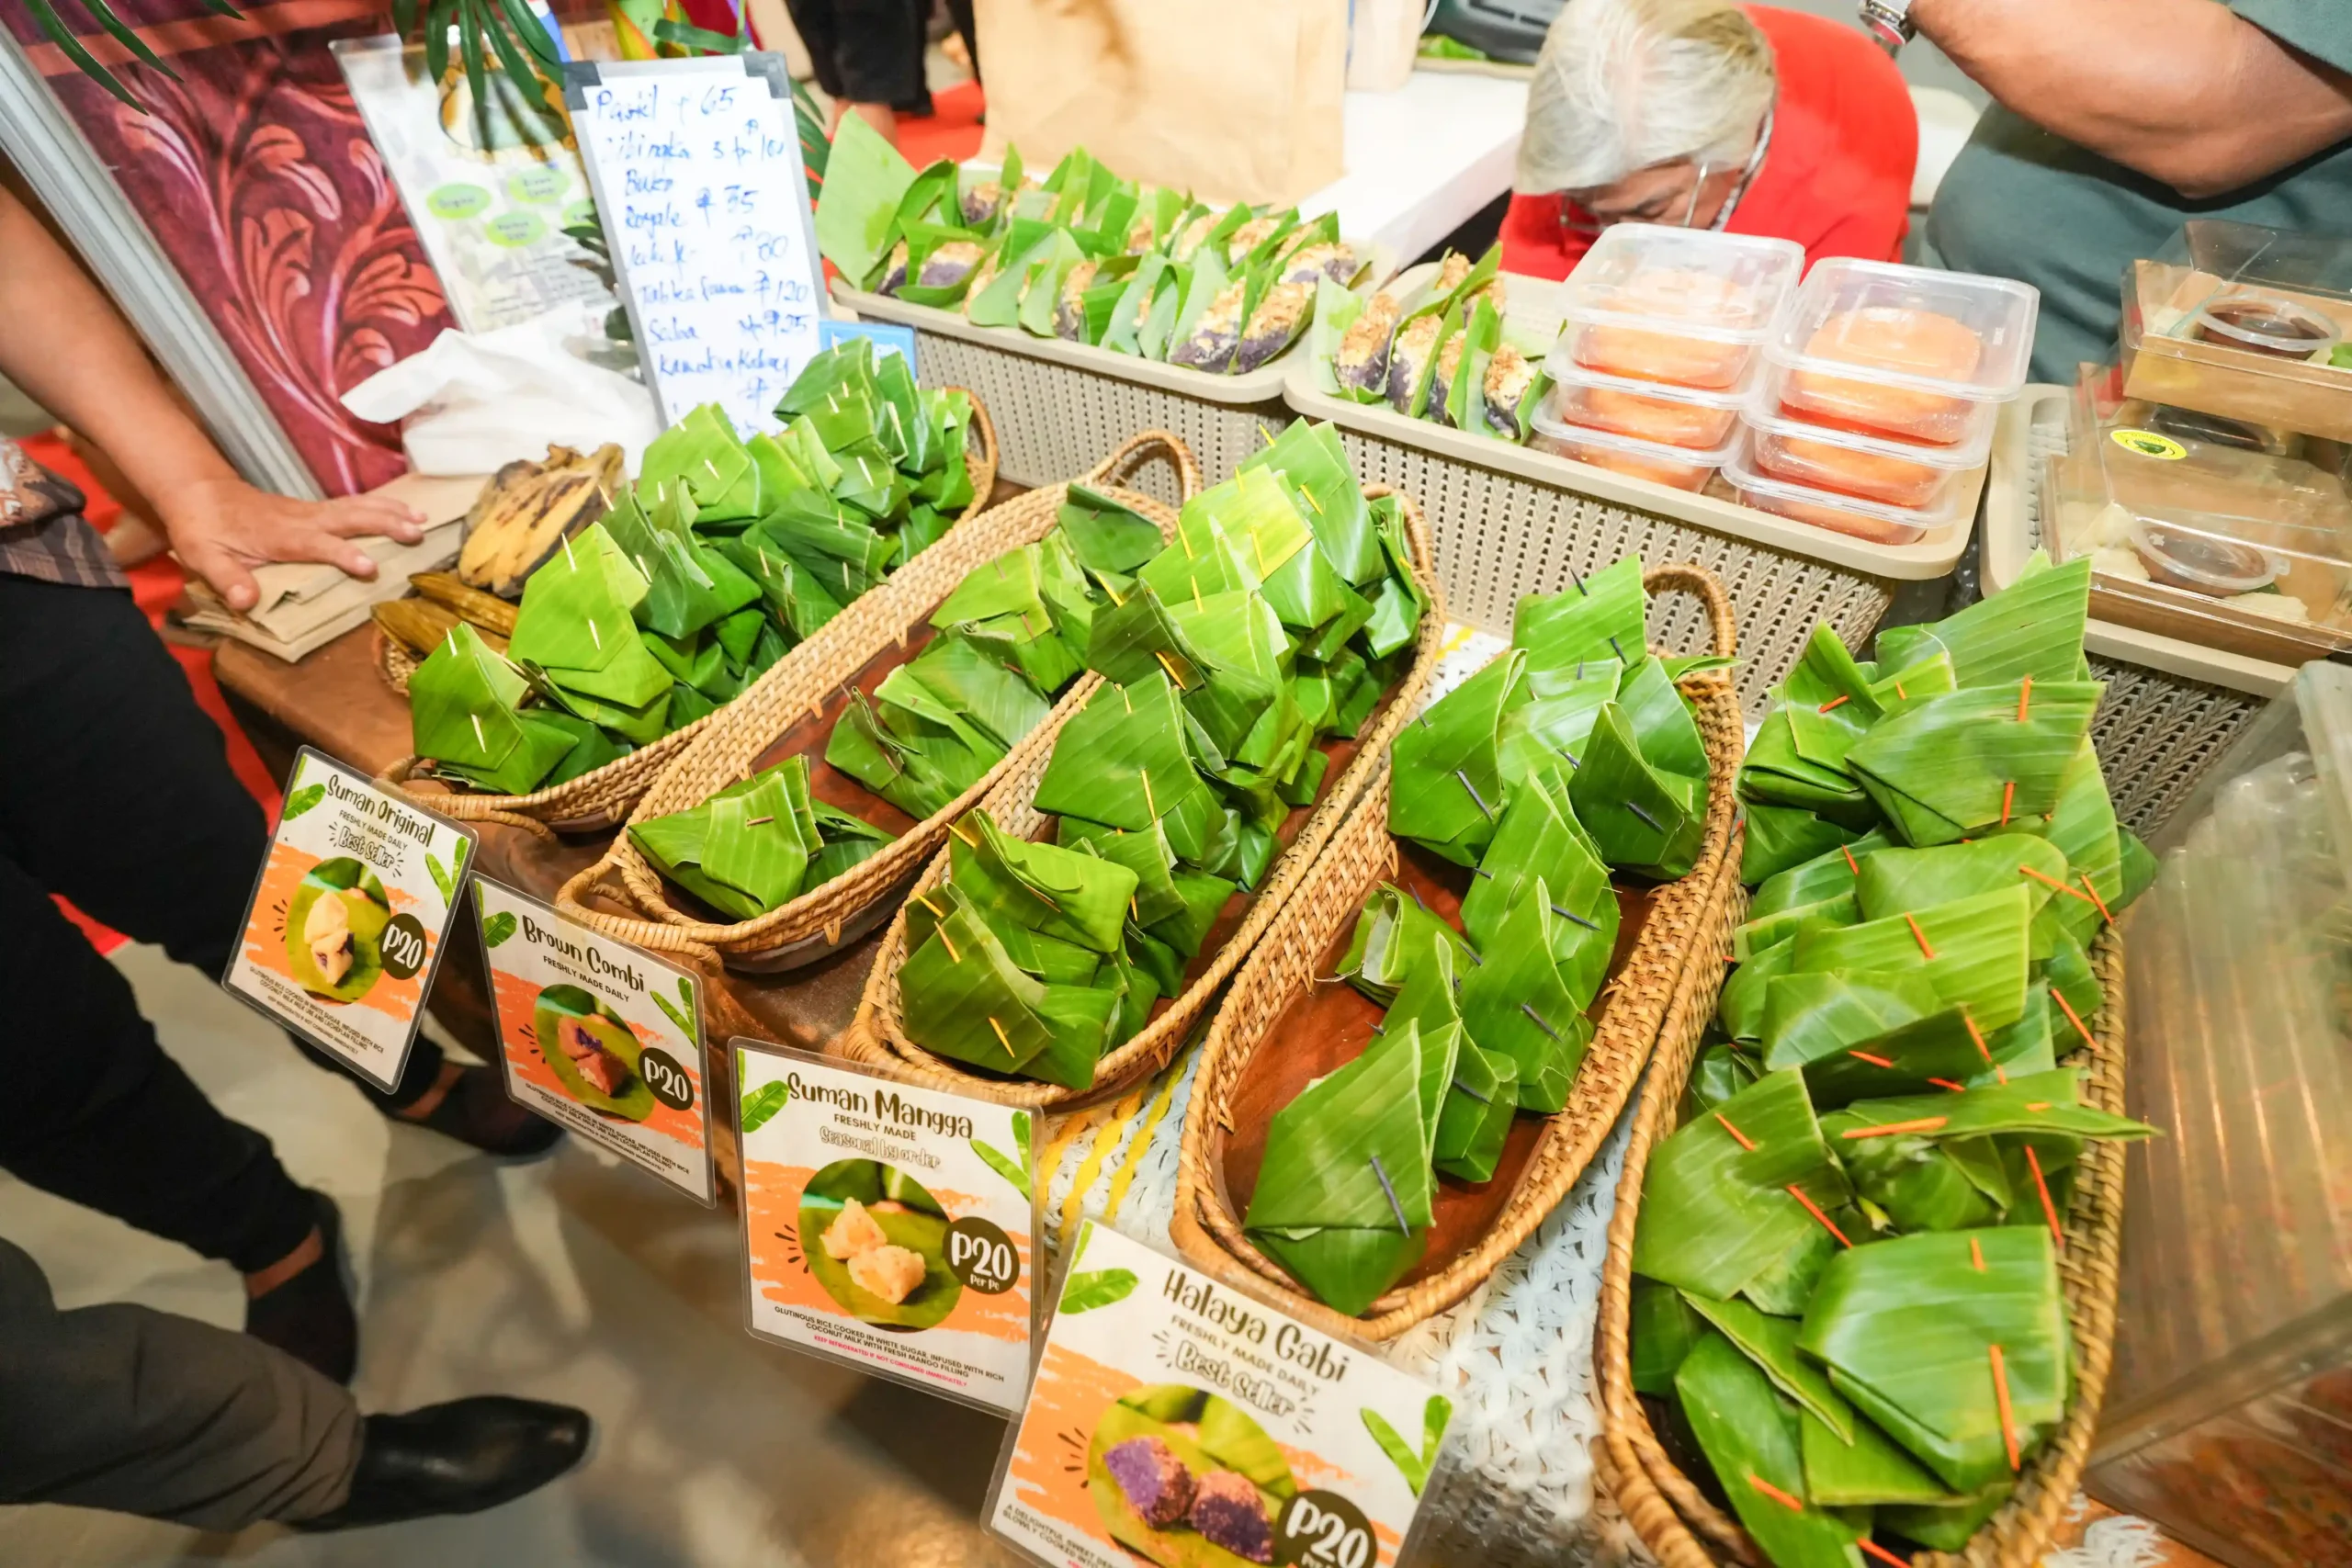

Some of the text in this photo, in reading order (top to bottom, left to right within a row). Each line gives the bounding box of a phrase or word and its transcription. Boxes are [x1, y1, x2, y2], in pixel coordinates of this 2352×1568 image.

[327, 774, 435, 848] Suman Original
[339, 809, 408, 851] FRESHLY MADE DAILY
[338, 826, 395, 869] Best Seller
[382, 923, 423, 969] P20
[522, 915, 644, 992] Brown Combi
[249, 966, 275, 985] GLUTINOUS
[285, 987, 304, 1002] COOKED
[310, 1003, 324, 1015] WHITE
[342, 1022, 361, 1038] INFUSED
[361, 1034, 373, 1045] WITH
[259, 979, 282, 996] COCONUT
[282, 994, 294, 1003] MILK
[314, 1013, 324, 1022] AND
[543, 955, 629, 1002] FRESHLY MADE DAILY
[644, 1056, 688, 1101] P20
[787, 1072, 973, 1139] Suman Mangga
[568, 1106, 591, 1121] COOKED
[597, 1122, 616, 1134] WHITE
[638, 1142, 662, 1157] INFUSED
[662, 1156, 676, 1167] WITH
[607, 1132, 619, 1141] AND
[834, 1113, 916, 1141] FRESHLY MADE
[880, 1139, 899, 1161] by
[900, 1148, 941, 1169] order
[951, 1231, 1012, 1280] P20
[775, 1305, 815, 1324] GLUTINOUS
[816, 1318, 832, 1328] RICE
[833, 1324, 865, 1338] COOKED
[876, 1337, 899, 1348] WHITE
[930, 1354, 963, 1368] INFUSED
[964, 1363, 984, 1375] WITH
[985, 1371, 1005, 1382] RICH
[806, 1322, 969, 1378] COCONUT MILK WITH FRESH MANGO FILLING
[1163, 1269, 1351, 1382] Halaya Gabi
[814, 1335, 828, 1343] KEEP
[828, 1338, 869, 1356] REFRIGERATED
[889, 1359, 925, 1374] CONSUMED
[925, 1370, 967, 1387] IMMEDIATELY
[1171, 1314, 1320, 1396] FRESHLY MADE DAILY
[1175, 1339, 1295, 1417] Best Seller
[1002, 1509, 1039, 1534] SLOWLY
[1039, 1531, 1075, 1558] COOKED
[1005, 1503, 1012, 1511] A
[1014, 1508, 1063, 1542] DELIGHTFUL
[1067, 1539, 1095, 1560] SWEET
[1286, 1496, 1369, 1568] P20
